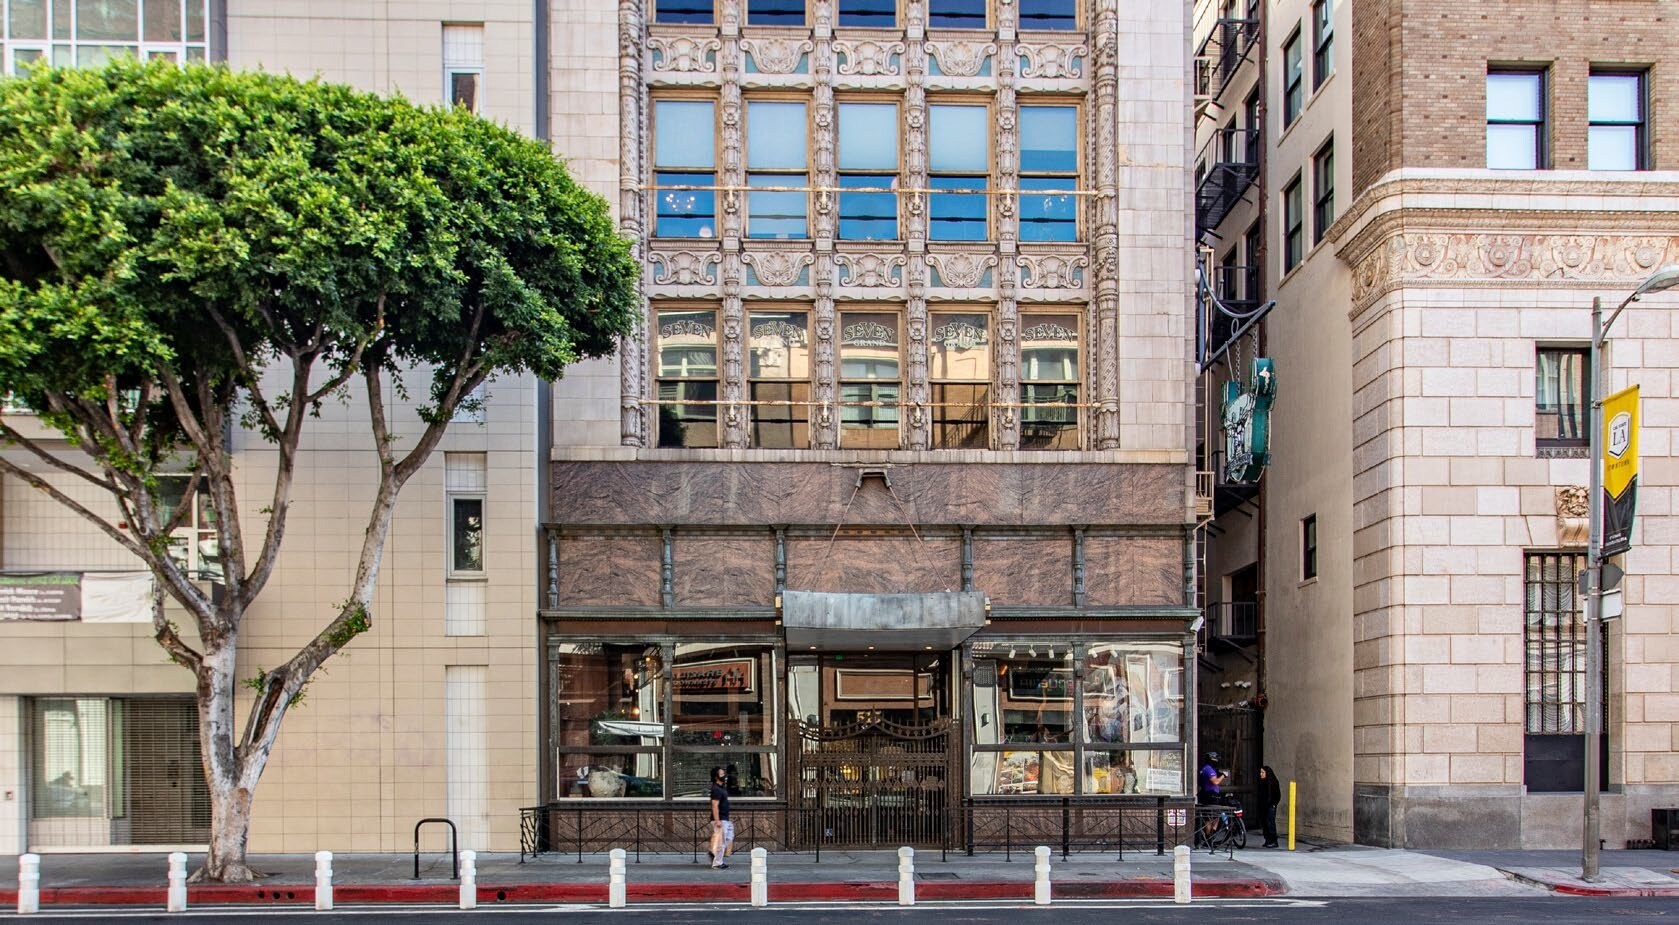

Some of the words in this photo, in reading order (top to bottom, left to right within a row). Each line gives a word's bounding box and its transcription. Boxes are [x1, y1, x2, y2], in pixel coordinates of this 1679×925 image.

[662, 320, 713, 339] SEVEN
[753, 320, 804, 341] SEVEN
[844, 321, 895, 342] SEVEN
[935, 322, 986, 342] SEVEN
[1024, 324, 1075, 343] SEVEN
[1613, 429, 1626, 446] LA
